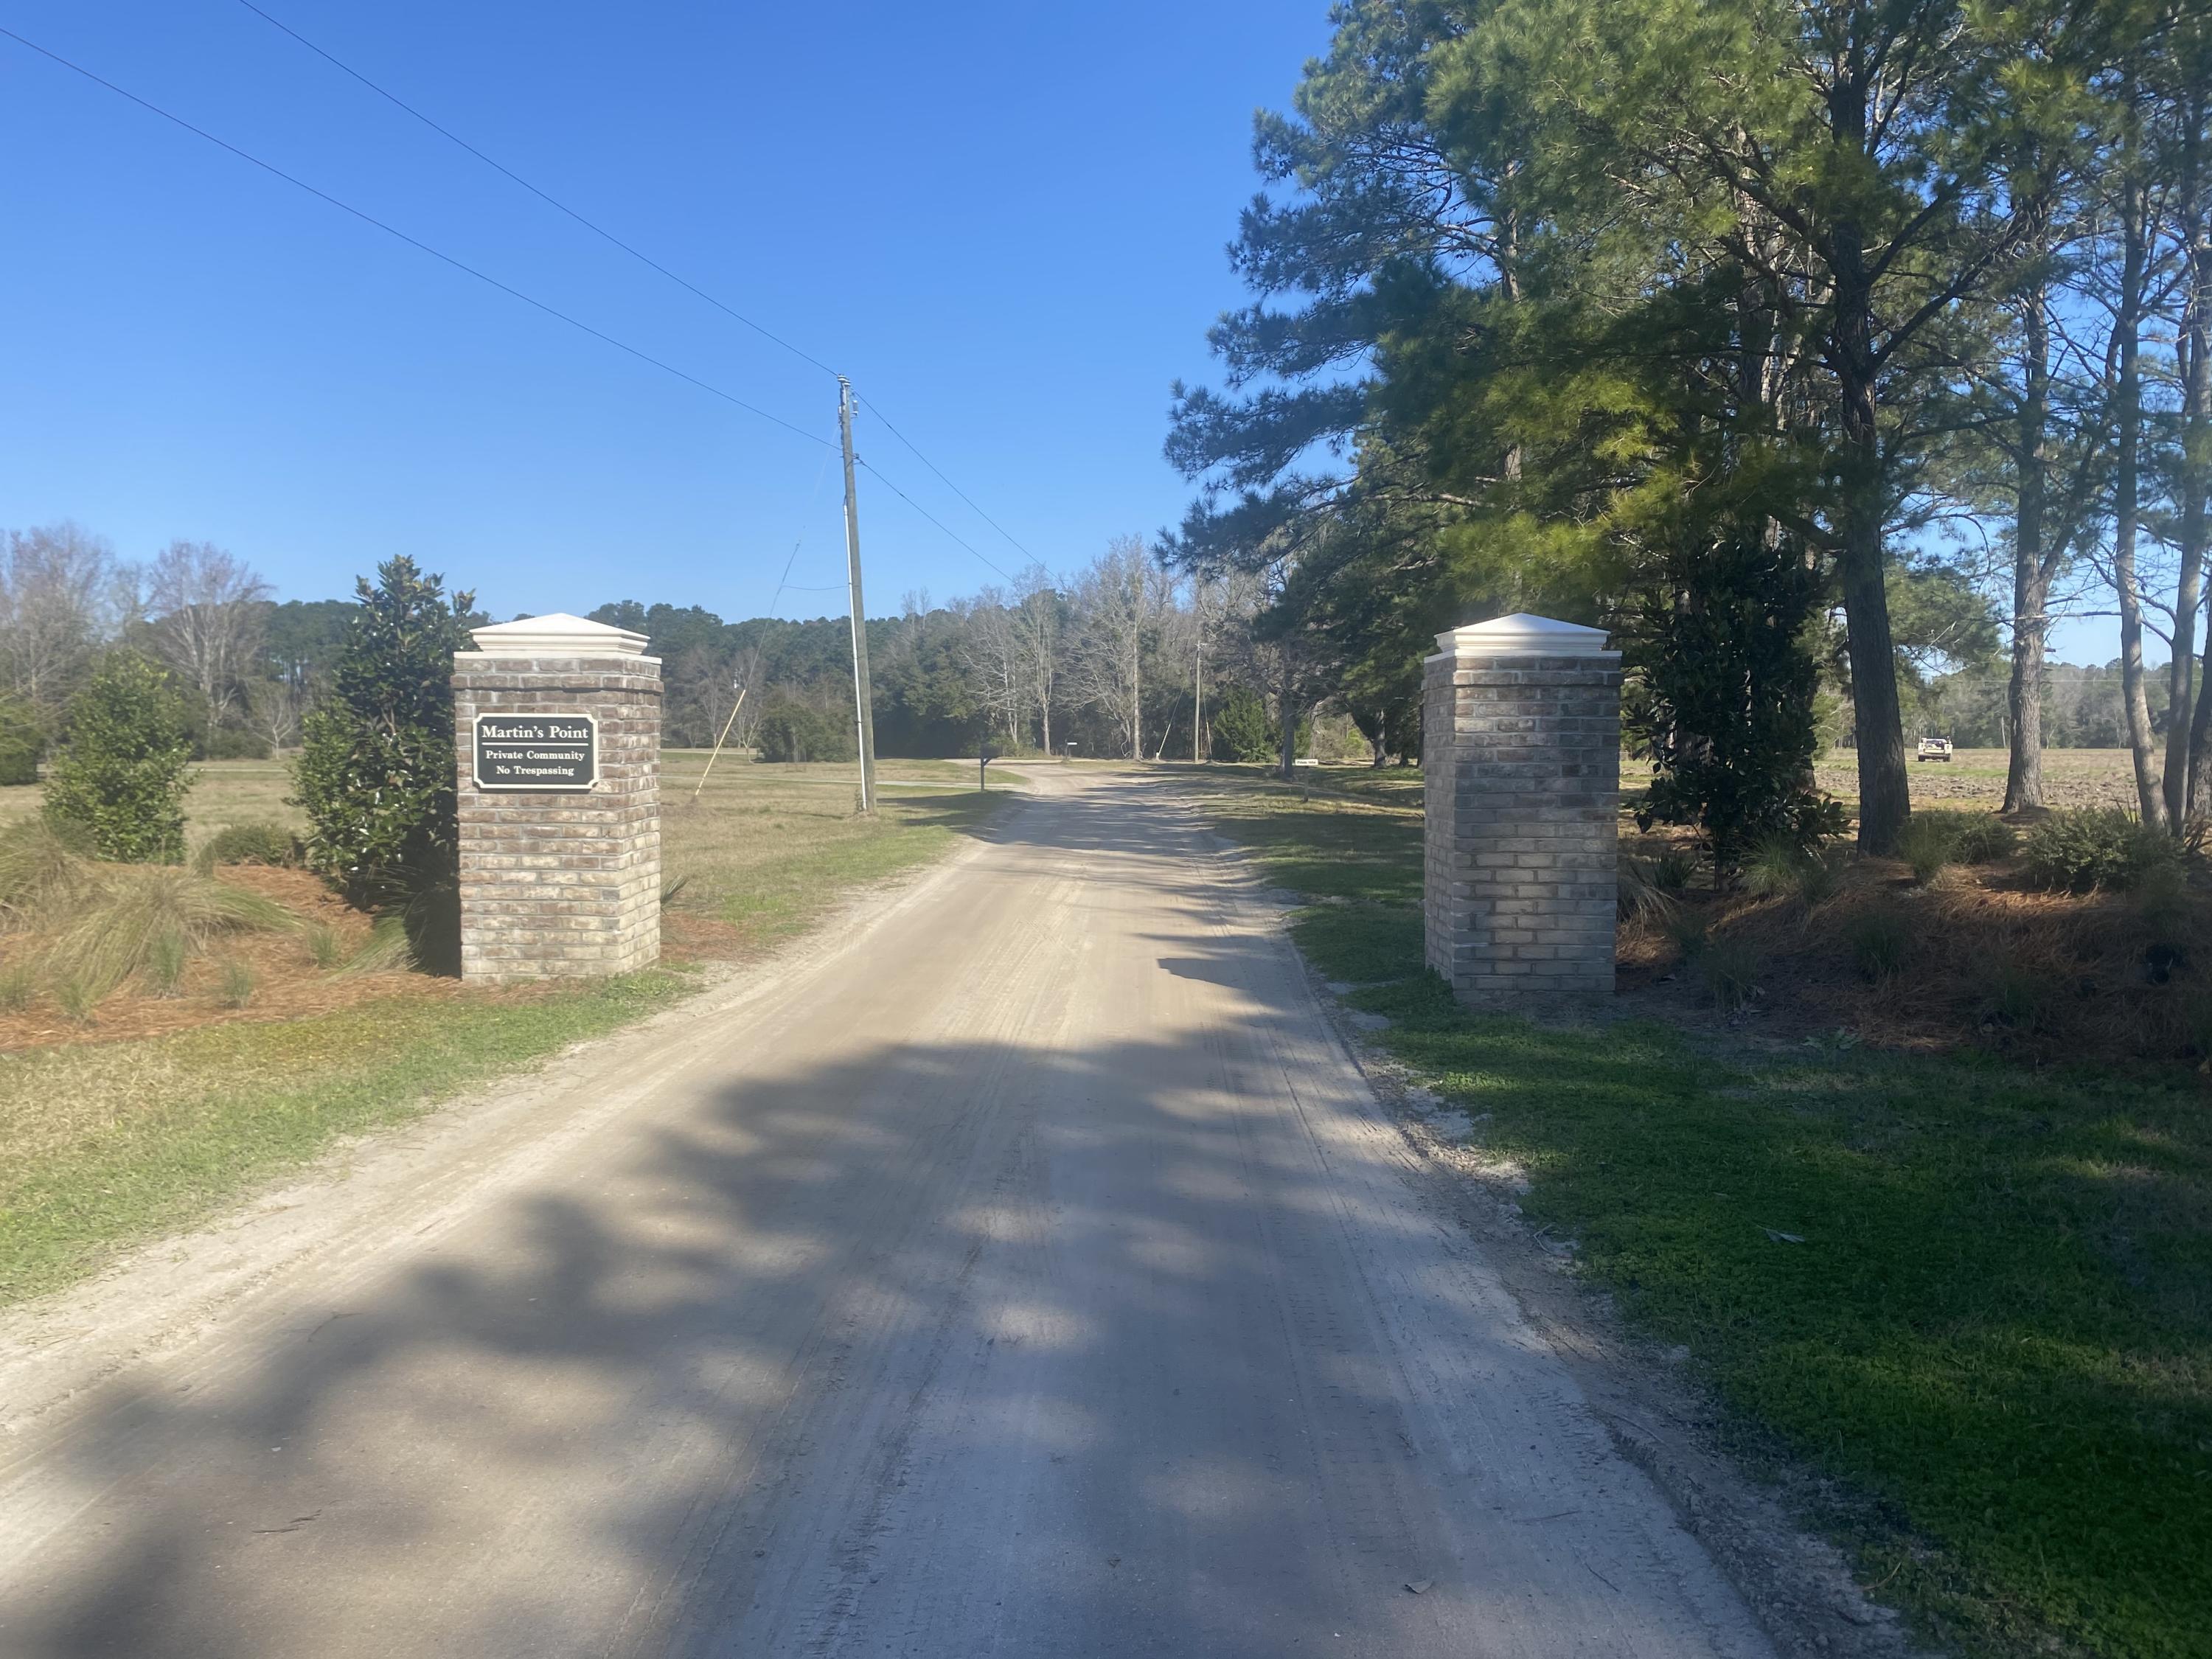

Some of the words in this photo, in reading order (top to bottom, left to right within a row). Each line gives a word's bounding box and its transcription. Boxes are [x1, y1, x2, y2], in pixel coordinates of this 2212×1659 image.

[481, 726, 544, 738] Martin's
[549, 726, 588, 738] Point
[485, 751, 523, 759] Private
[526, 751, 585, 762] Community
[496, 765, 510, 774] No
[513, 765, 574, 776] Trespassing
